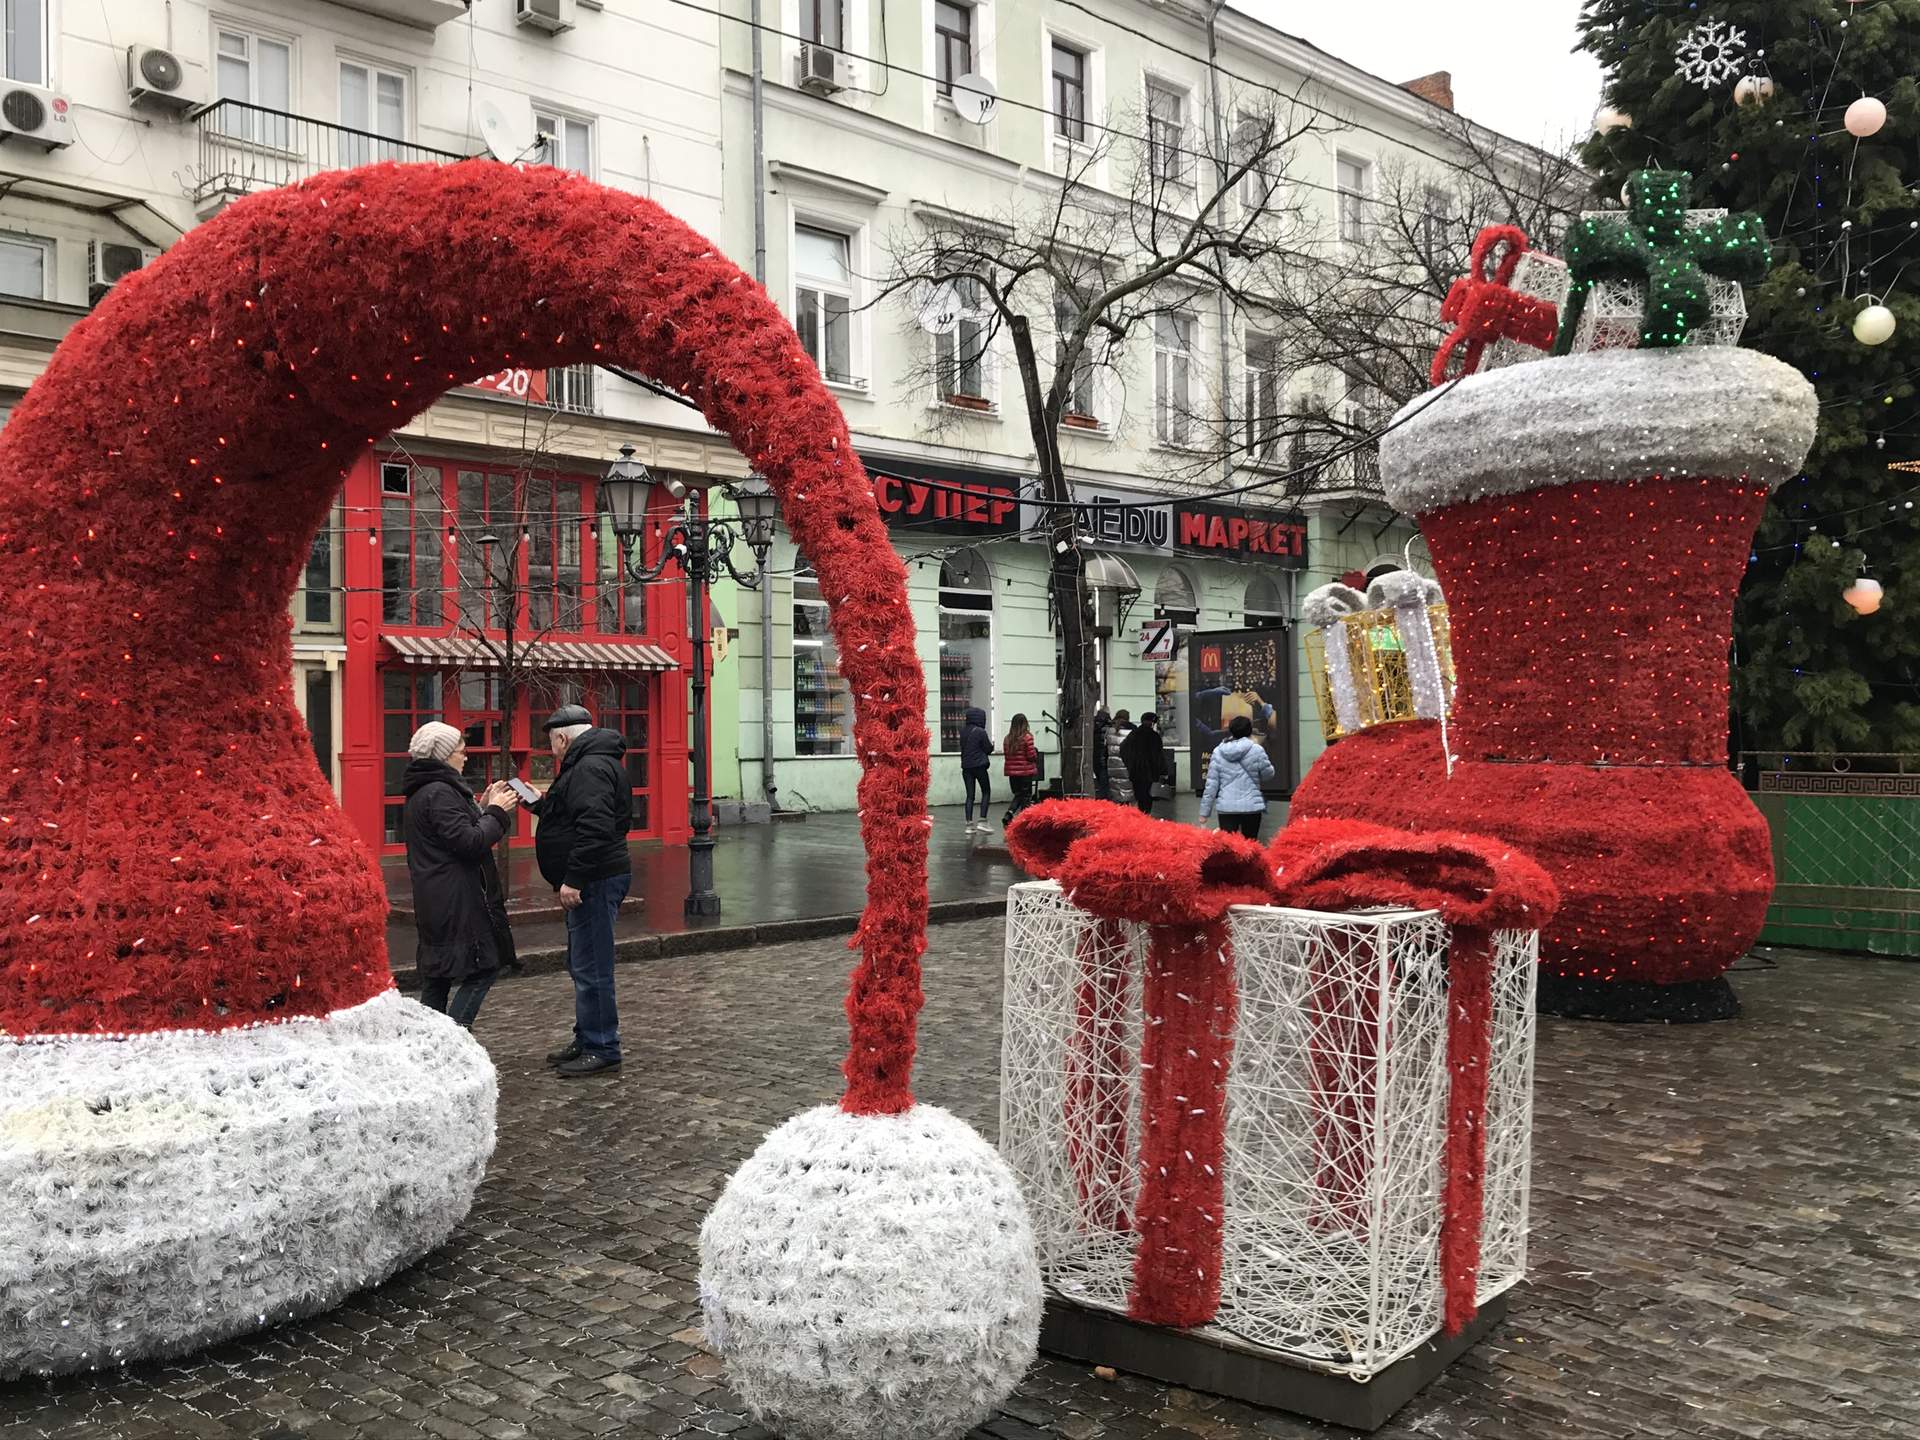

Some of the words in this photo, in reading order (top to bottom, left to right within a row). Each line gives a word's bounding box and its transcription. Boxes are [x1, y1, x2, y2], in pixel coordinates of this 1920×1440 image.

[54, 113, 66, 123] LG
[473, 367, 529, 396] -20
[874, 475, 1016, 525] СУПЕР
[1180, 511, 1307, 556] МАРКЕТ
